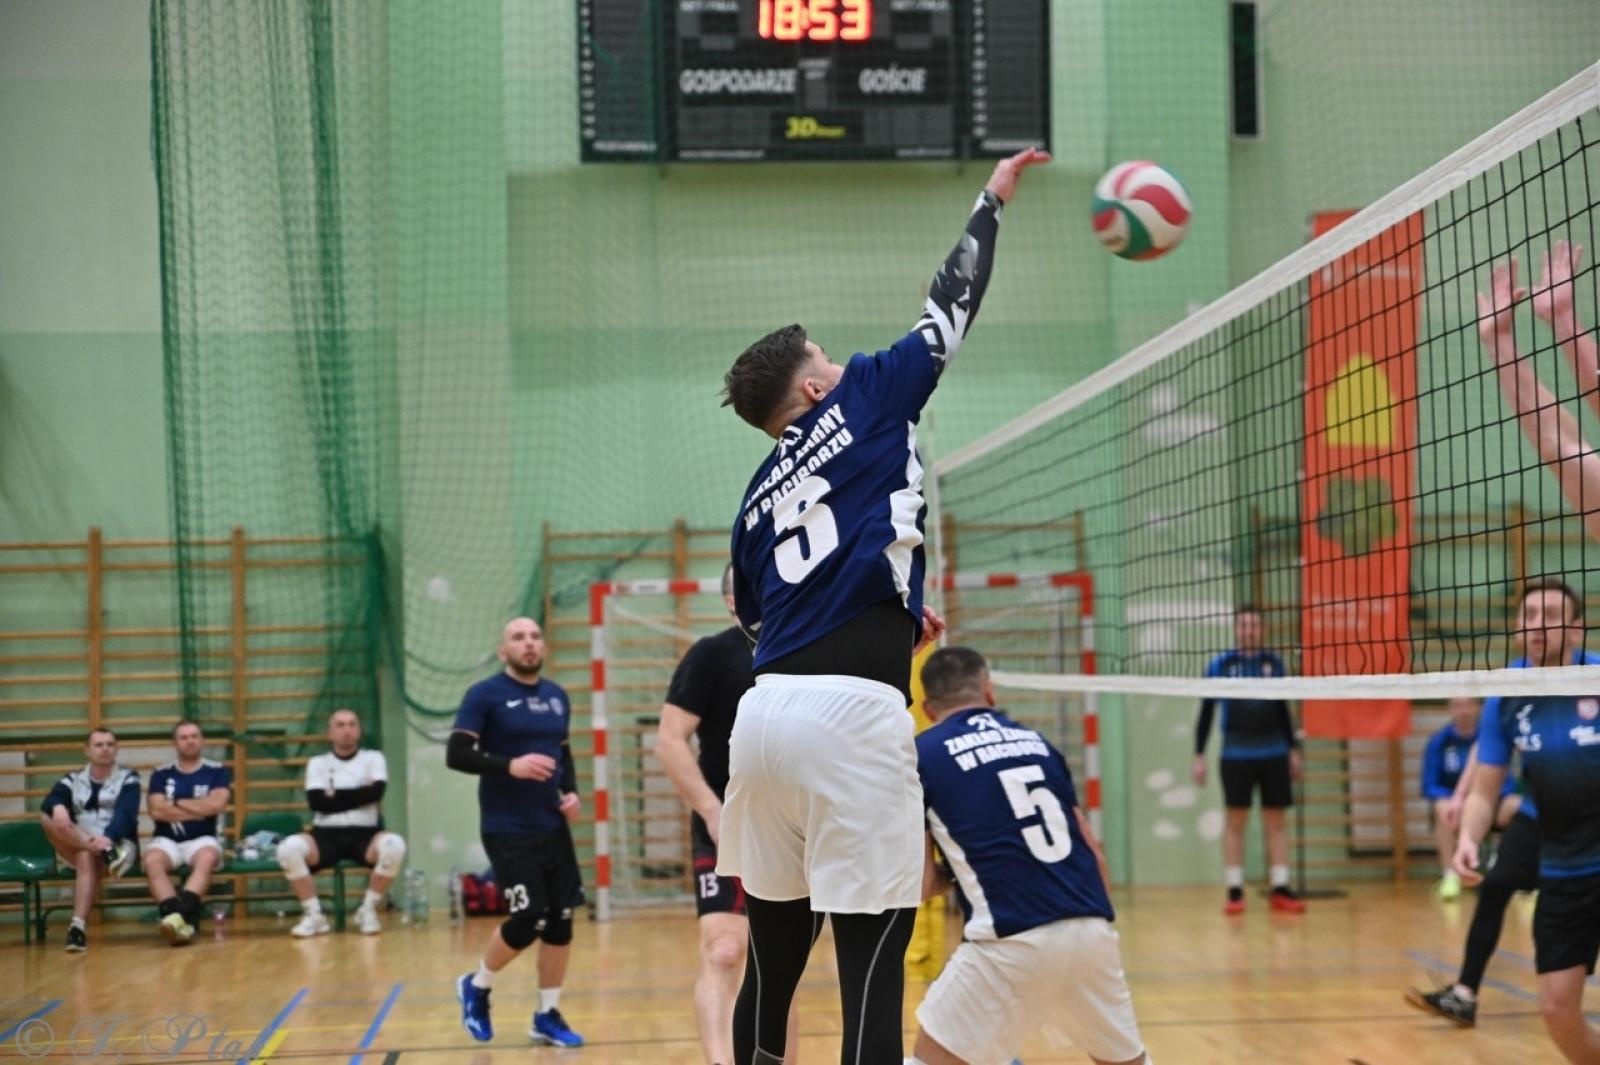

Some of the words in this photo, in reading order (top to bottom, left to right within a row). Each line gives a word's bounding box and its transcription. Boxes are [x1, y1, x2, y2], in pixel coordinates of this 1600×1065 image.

[758, 0, 873, 40] 18:53
[680, 68, 797, 94] GOSPODARZE
[860, 64, 926, 93] GOŚCIE
[743, 507, 759, 531] W
[997, 764, 1072, 864] 5
[504, 884, 530, 913] 23
[699, 874, 719, 898] 13
